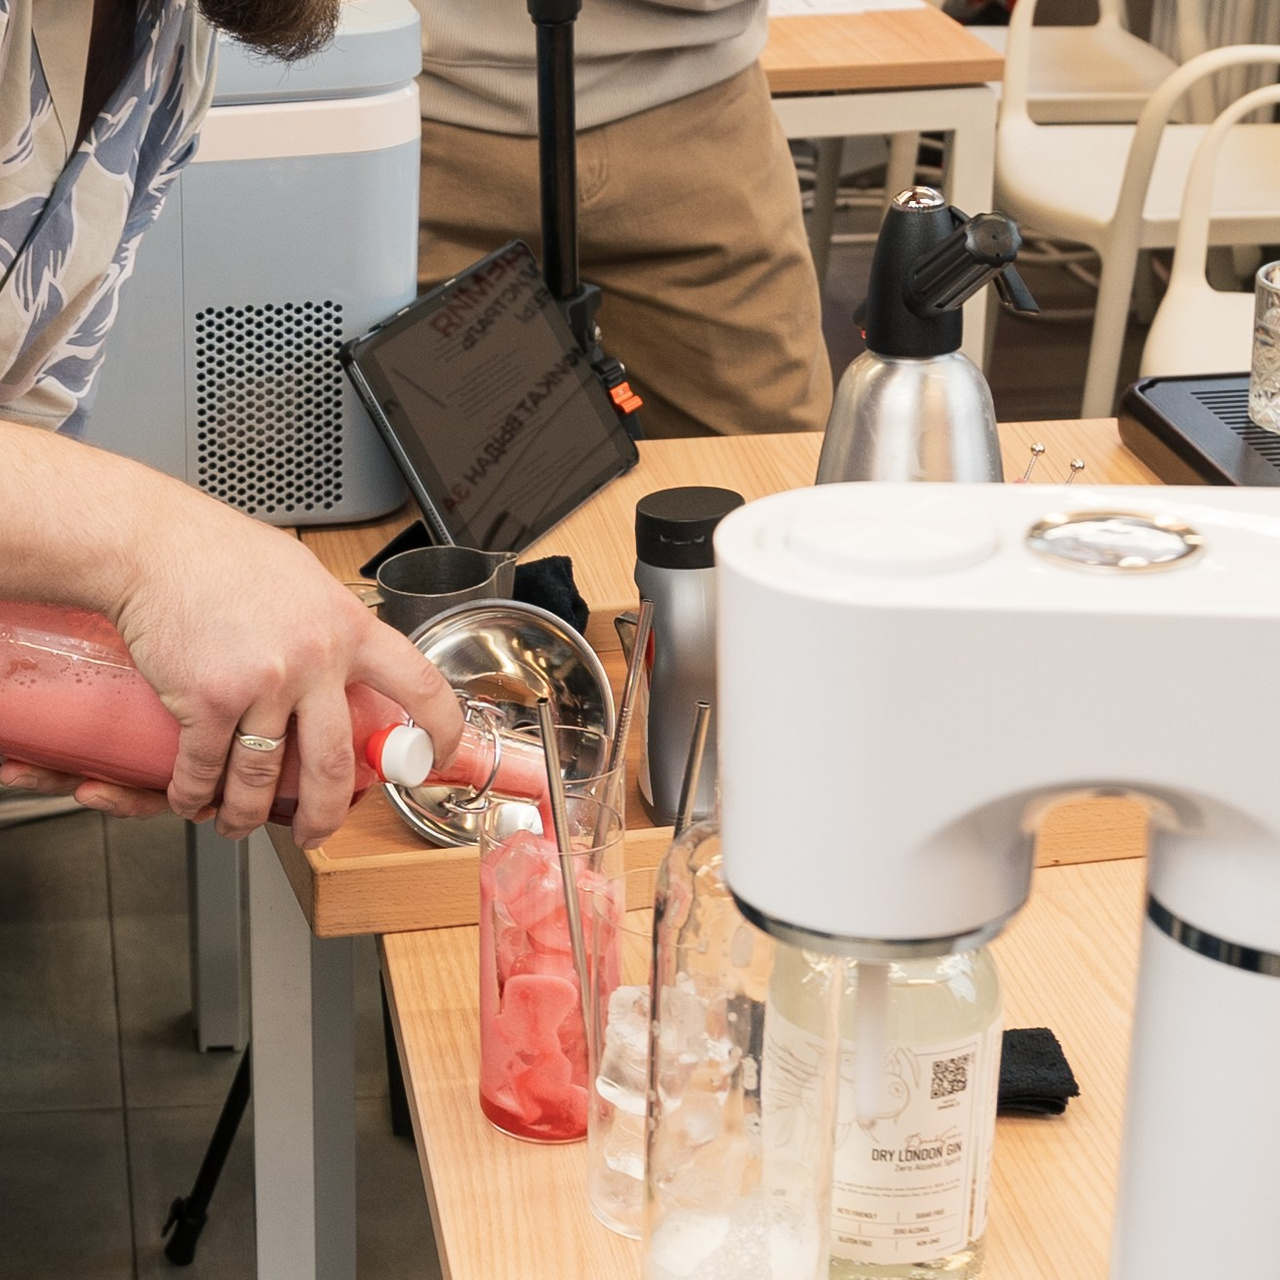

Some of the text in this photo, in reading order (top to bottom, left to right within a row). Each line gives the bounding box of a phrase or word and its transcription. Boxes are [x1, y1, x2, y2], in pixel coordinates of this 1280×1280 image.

[871, 1141, 962, 1162] DRY LONDON GIN
